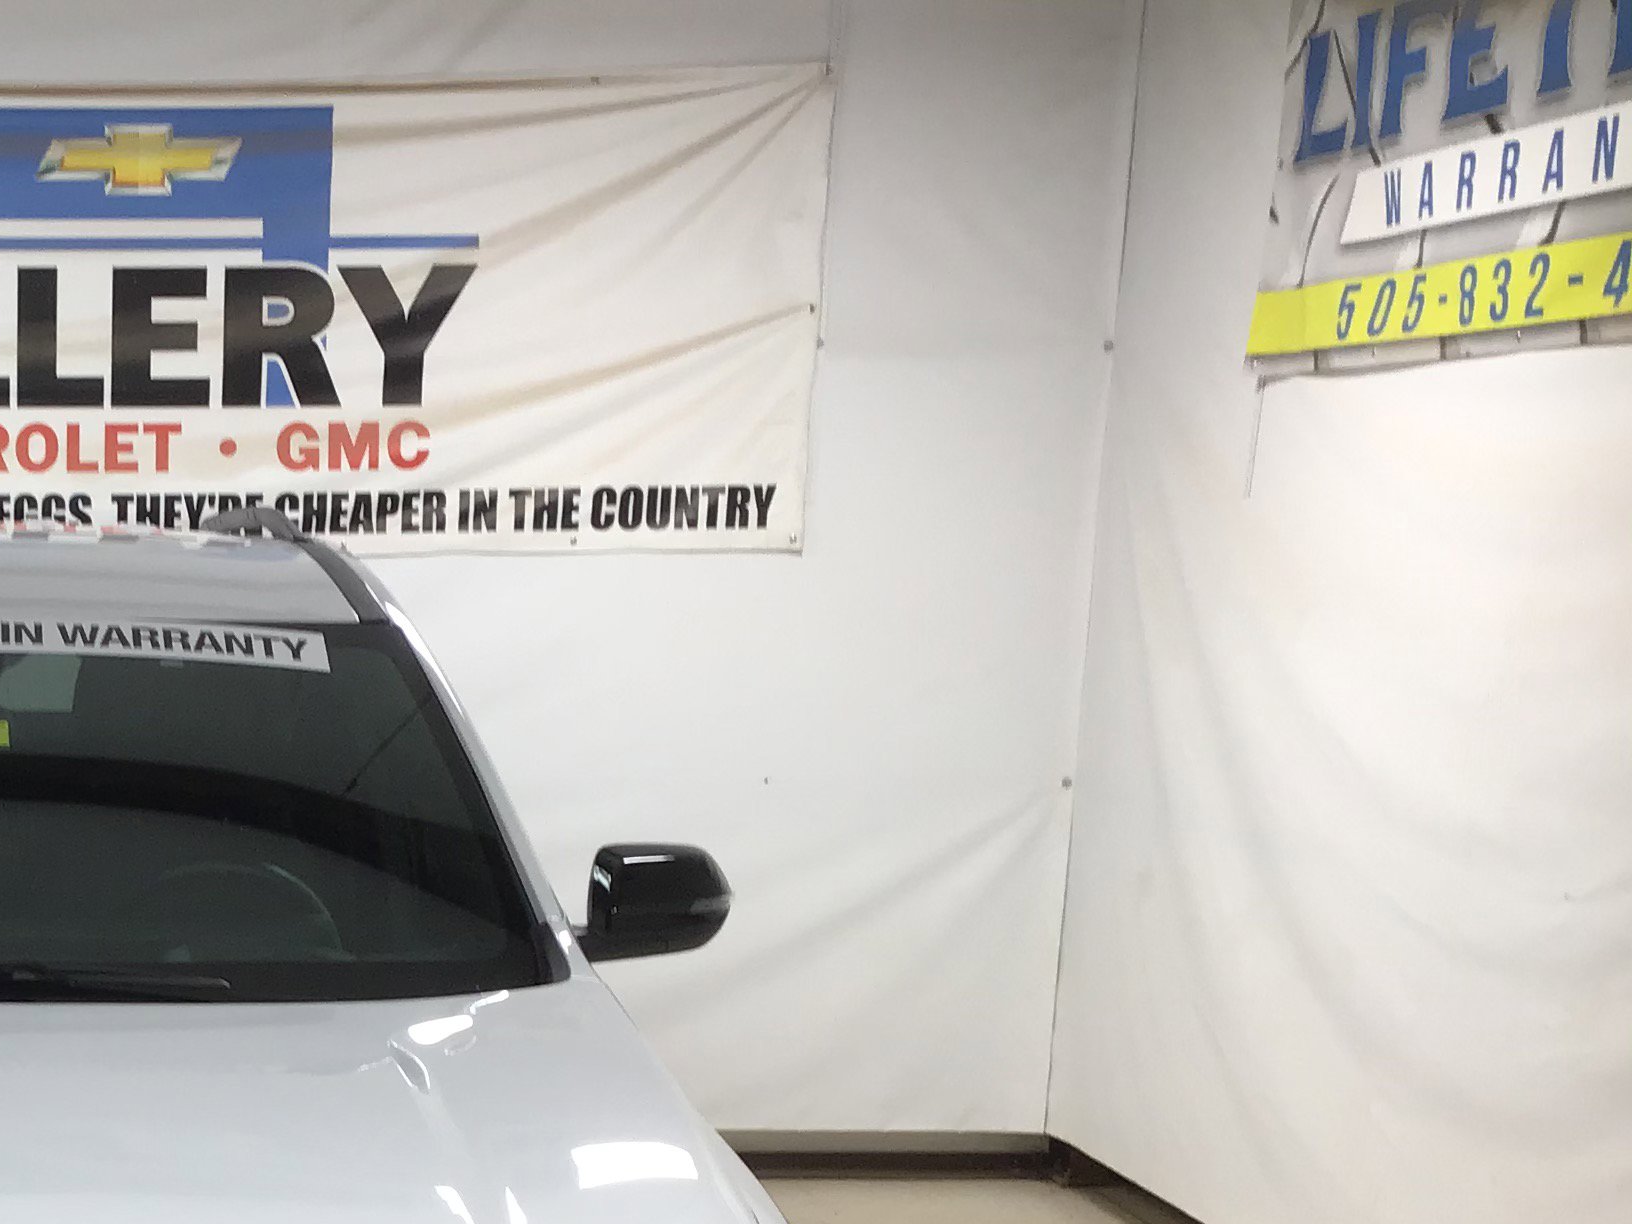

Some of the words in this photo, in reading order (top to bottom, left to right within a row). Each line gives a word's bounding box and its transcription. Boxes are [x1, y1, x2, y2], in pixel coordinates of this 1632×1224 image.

[1384, 113, 1622, 228] WARRAN
[1337, 239, 1632, 340] 505-832-4
[276, 420, 431, 473] GMC
[275, 488, 447, 535] CHEAPER
[458, 488, 498, 532] IN
[509, 487, 581, 532] THE
[590, 484, 776, 531] COUNTRY
[57, 622, 307, 662] WARRANTY
